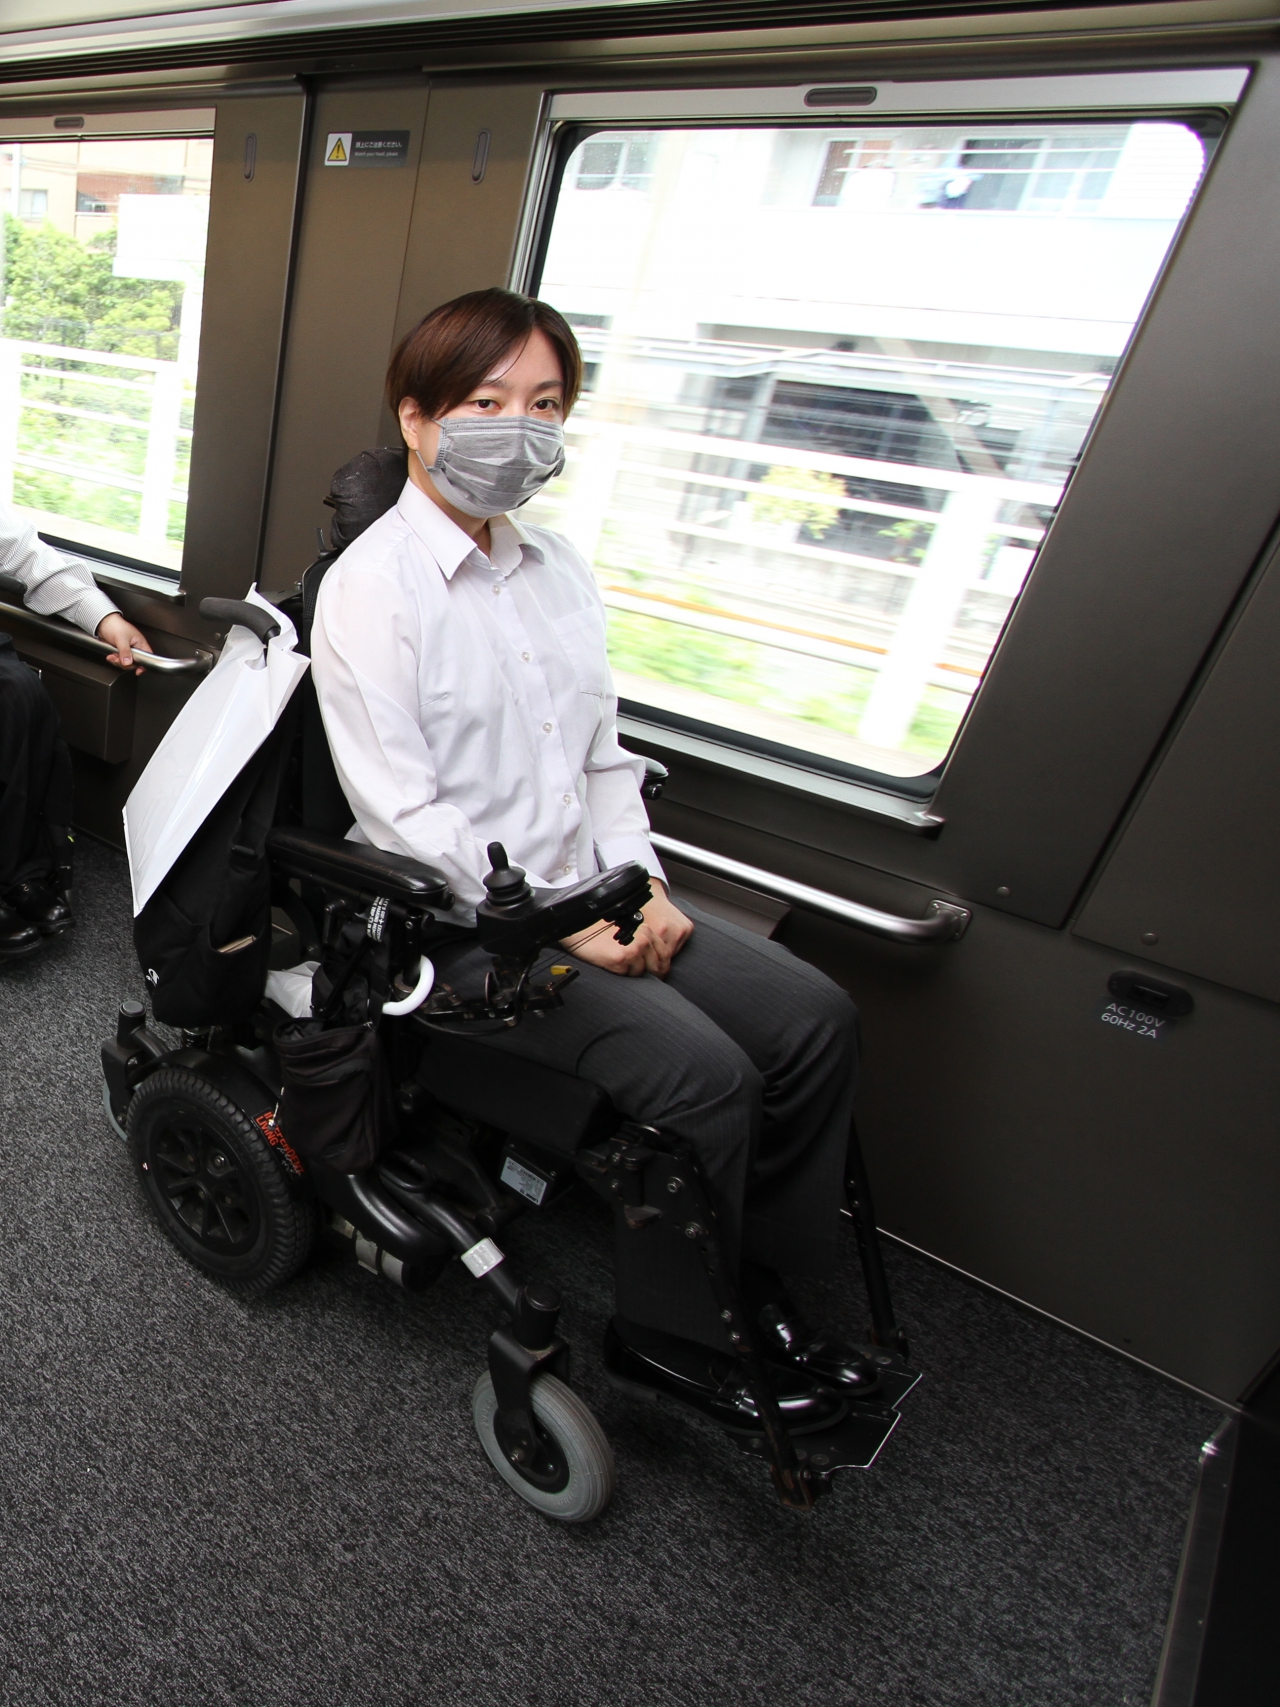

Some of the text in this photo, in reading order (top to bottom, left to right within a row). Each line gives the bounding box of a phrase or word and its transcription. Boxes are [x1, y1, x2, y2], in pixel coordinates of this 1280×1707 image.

[1101, 1012, 1157, 1039] 60Hz 2A
[256, 1115, 279, 1146] LIVING
